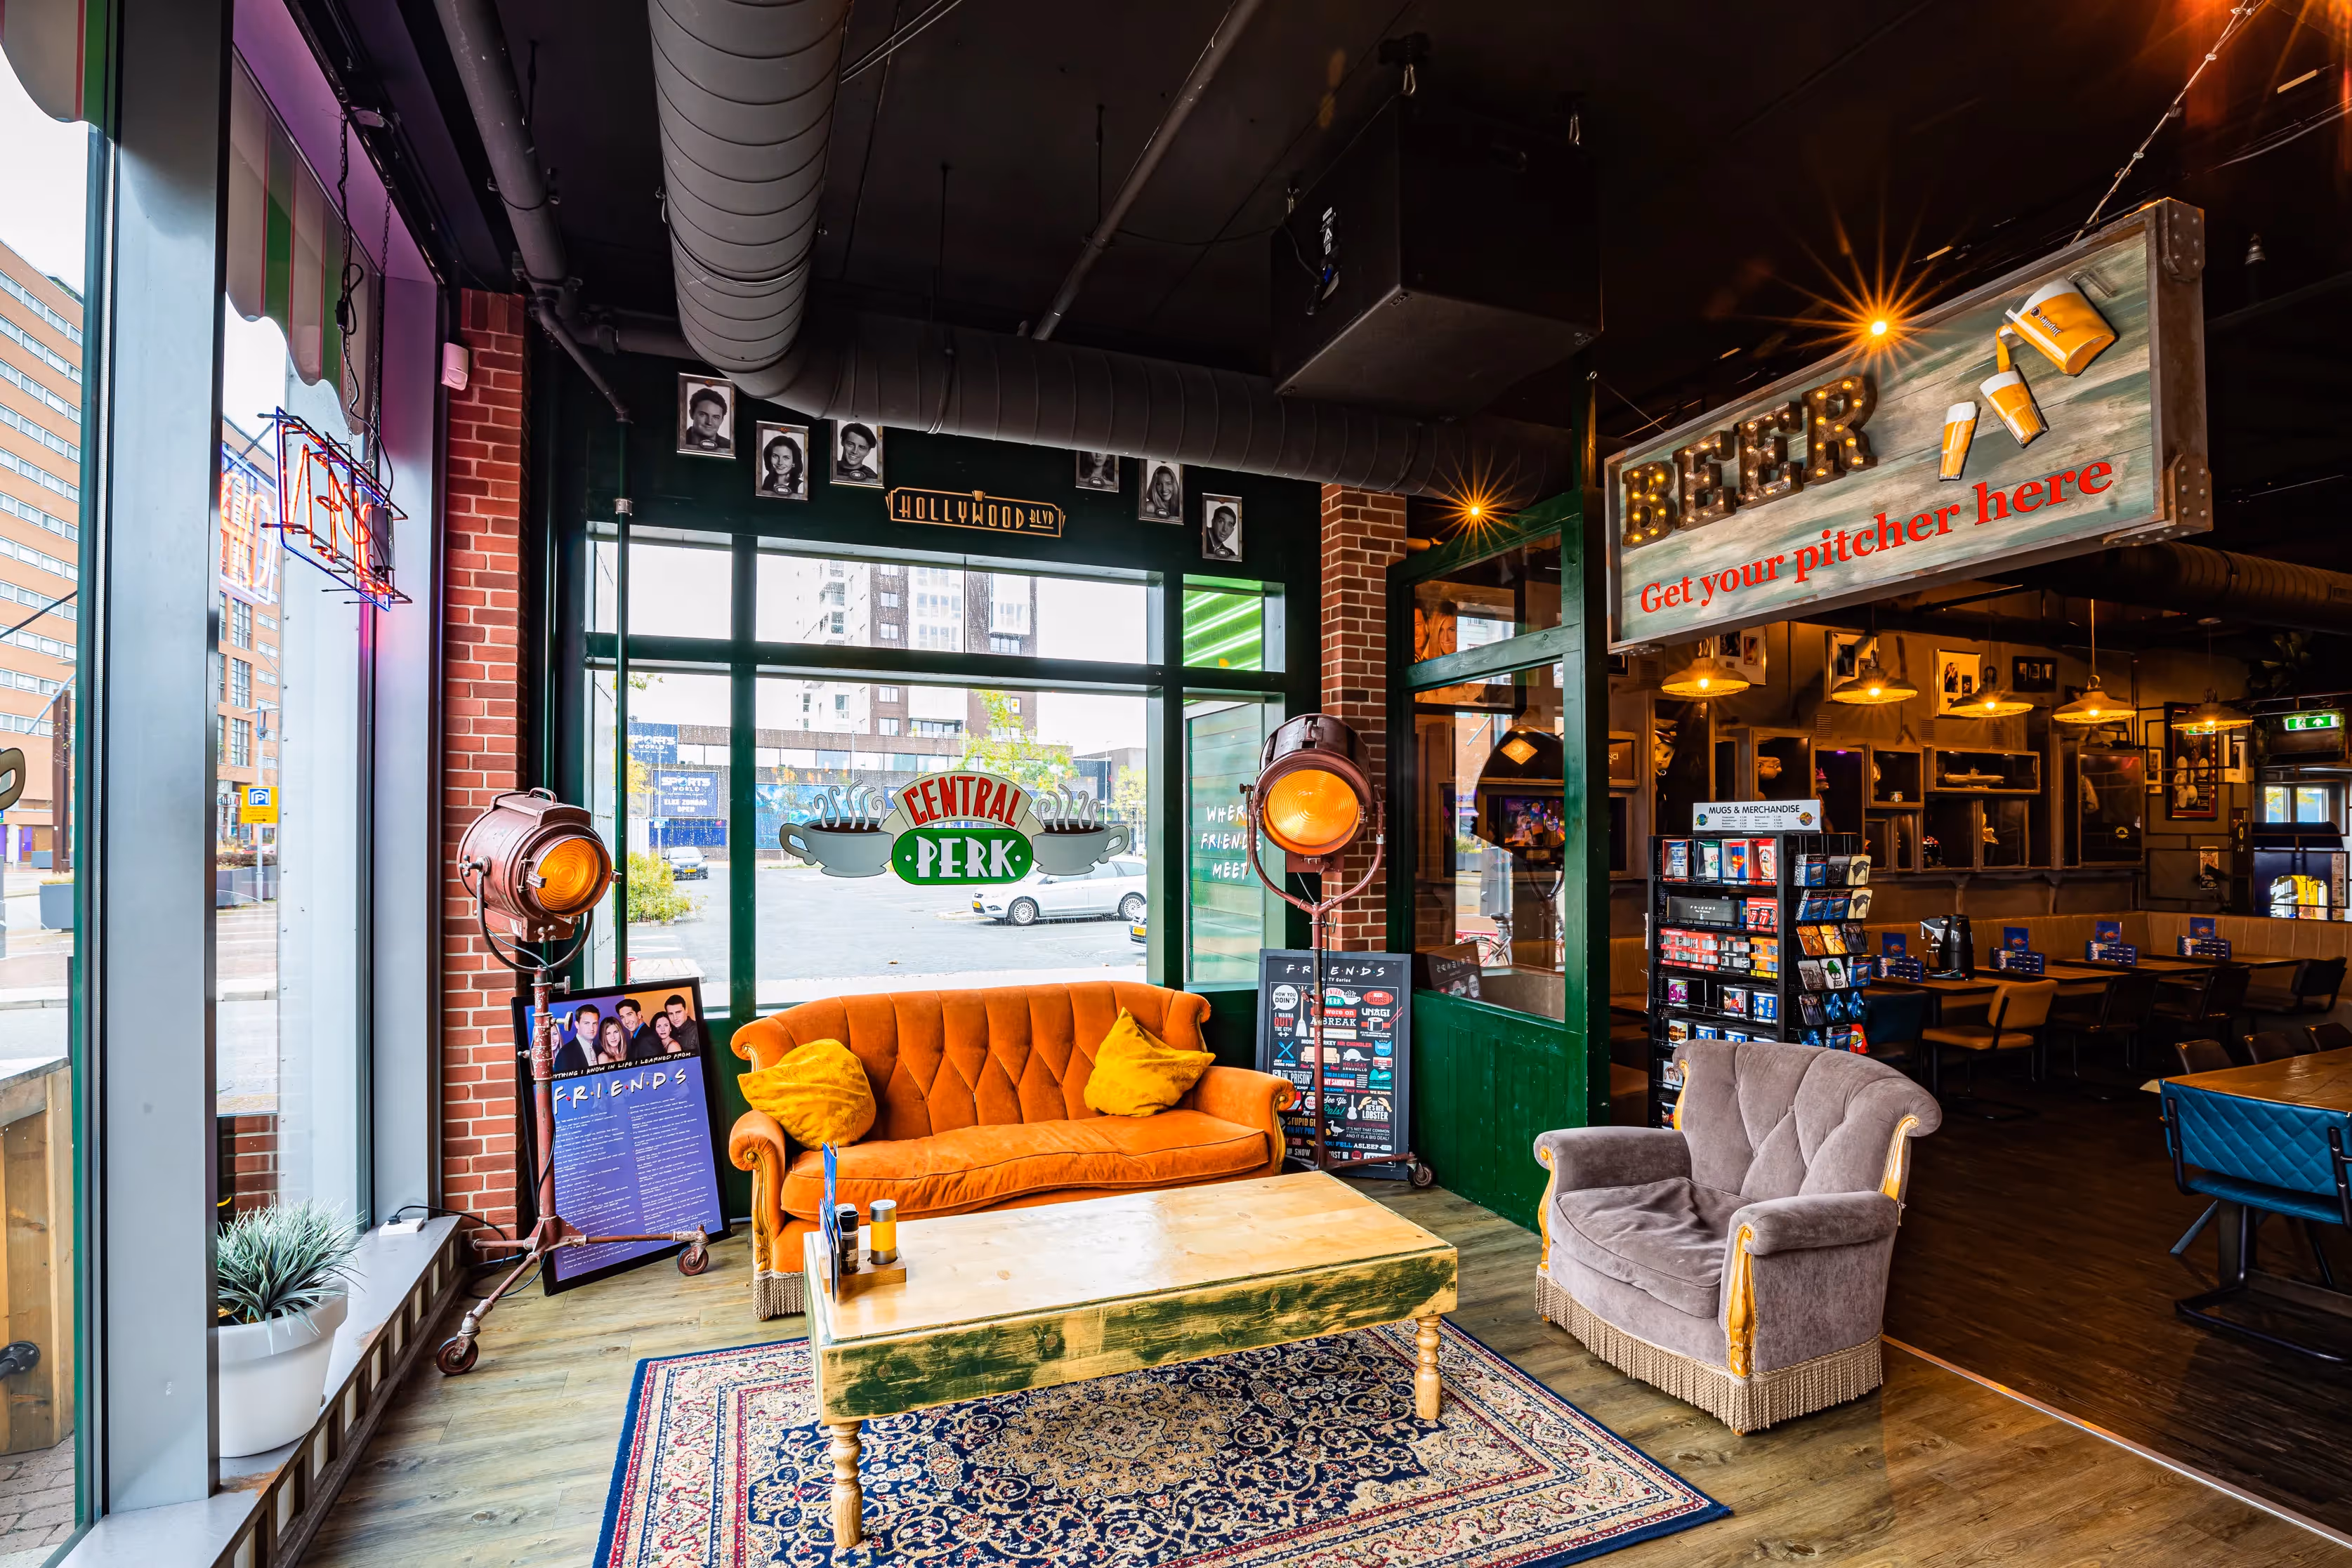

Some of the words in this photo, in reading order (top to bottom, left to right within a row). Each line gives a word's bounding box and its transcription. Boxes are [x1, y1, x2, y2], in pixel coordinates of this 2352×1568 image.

[2039, 315, 2062, 338] Jupiler
[1622, 375, 1878, 549] BEER
[898, 495, 1025, 529] HOLLYWOOD
[1029, 508, 1054, 526] BLVD
[1641, 576, 1693, 614] Get
[1700, 554, 1785, 607] your
[1794, 503, 1961, 584] pitcher
[1972, 461, 2114, 525] here
[661, 777, 711, 786] SPORTS
[902, 775, 1021, 827] CENTRAL
[1709, 806, 1732, 815] MUGS
[1742, 805, 1800, 814] MERCHANDISE
[915, 836, 1017, 878] PERK
[1212, 862, 1247, 880] MEET
[1286, 964, 1385, 977] FRENDS
[1362, 1008, 1391, 1017] UNAGI
[1274, 1017, 1294, 1027] QUIT
[640, 1055, 672, 1065] LEARNED
[553, 1068, 687, 1116] FRIENDS
[1324, 1095, 1335, 1104] See
[1336, 1097, 1347, 1106] Ya
[1324, 1104, 1346, 1115] Pals!
[1362, 1110, 1388, 1120] LOBSTER
[1304, 1127, 1315, 1135] PHO
[1294, 1148, 1310, 1157] SNOW
